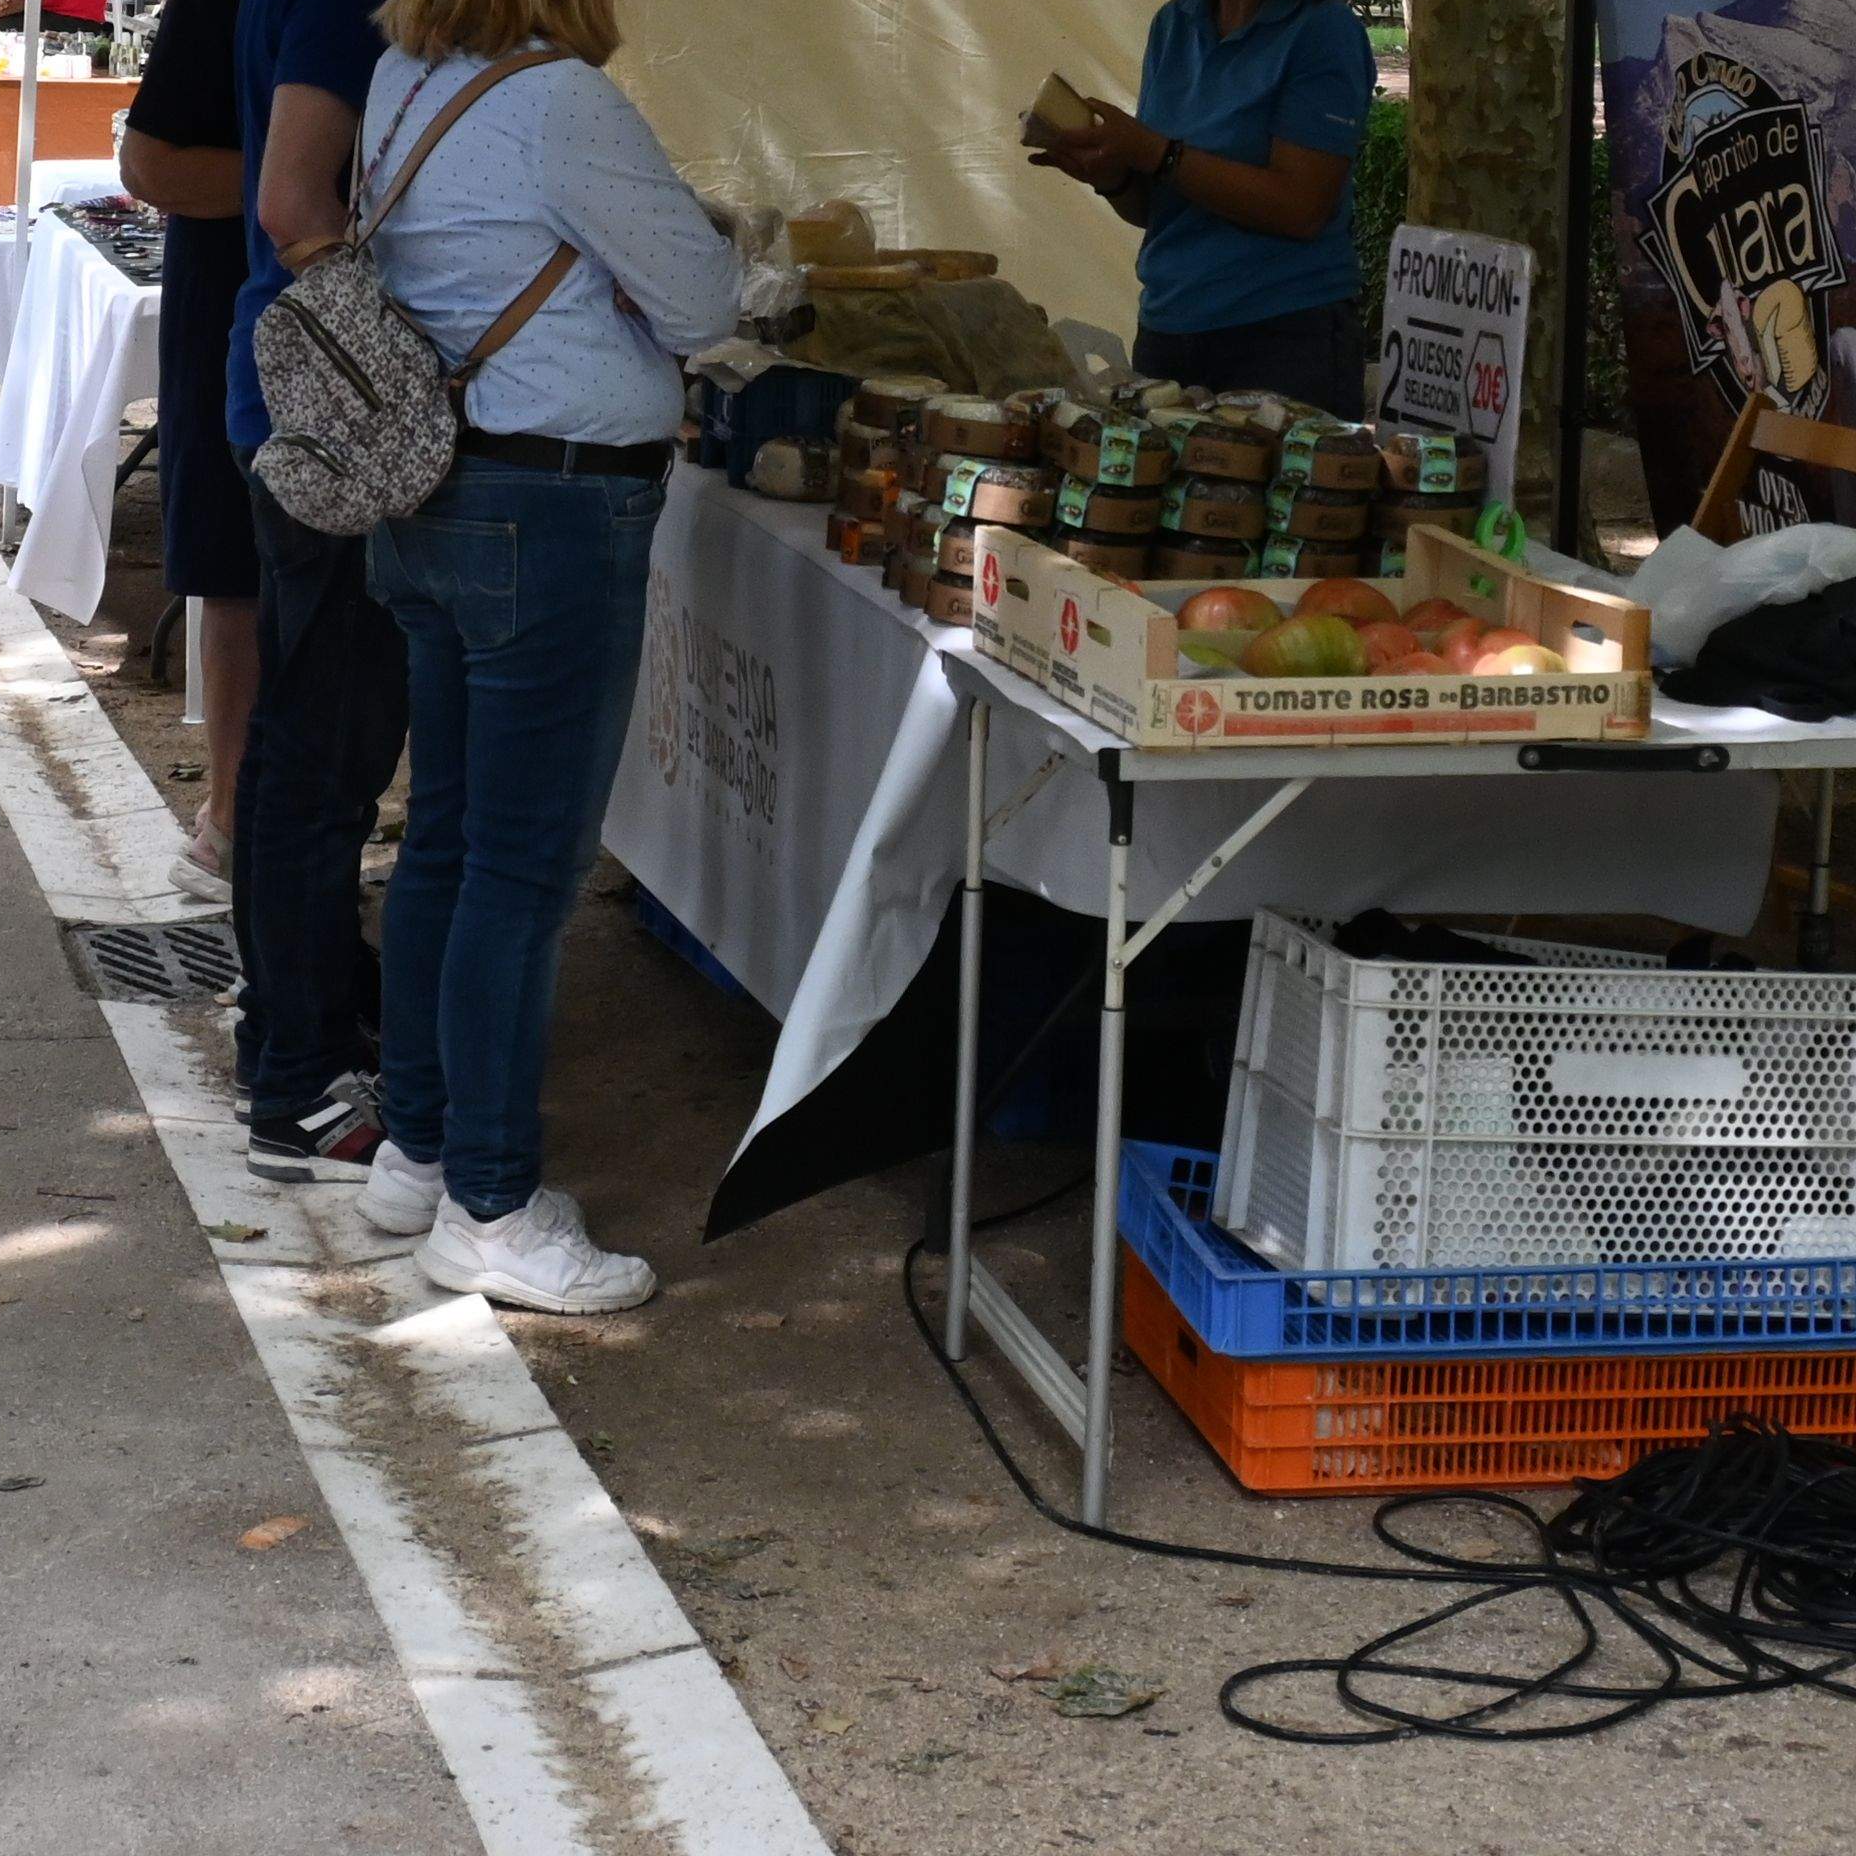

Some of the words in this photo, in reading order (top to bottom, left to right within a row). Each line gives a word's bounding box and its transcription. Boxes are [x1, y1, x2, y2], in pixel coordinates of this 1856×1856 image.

[1767, 116, 1799, 157] de
[1664, 169, 1816, 321] Guara
[1380, 330, 1403, 424] 2
[1407, 337, 1463, 381] QUESOS
[1472, 361, 1504, 415] 20€
